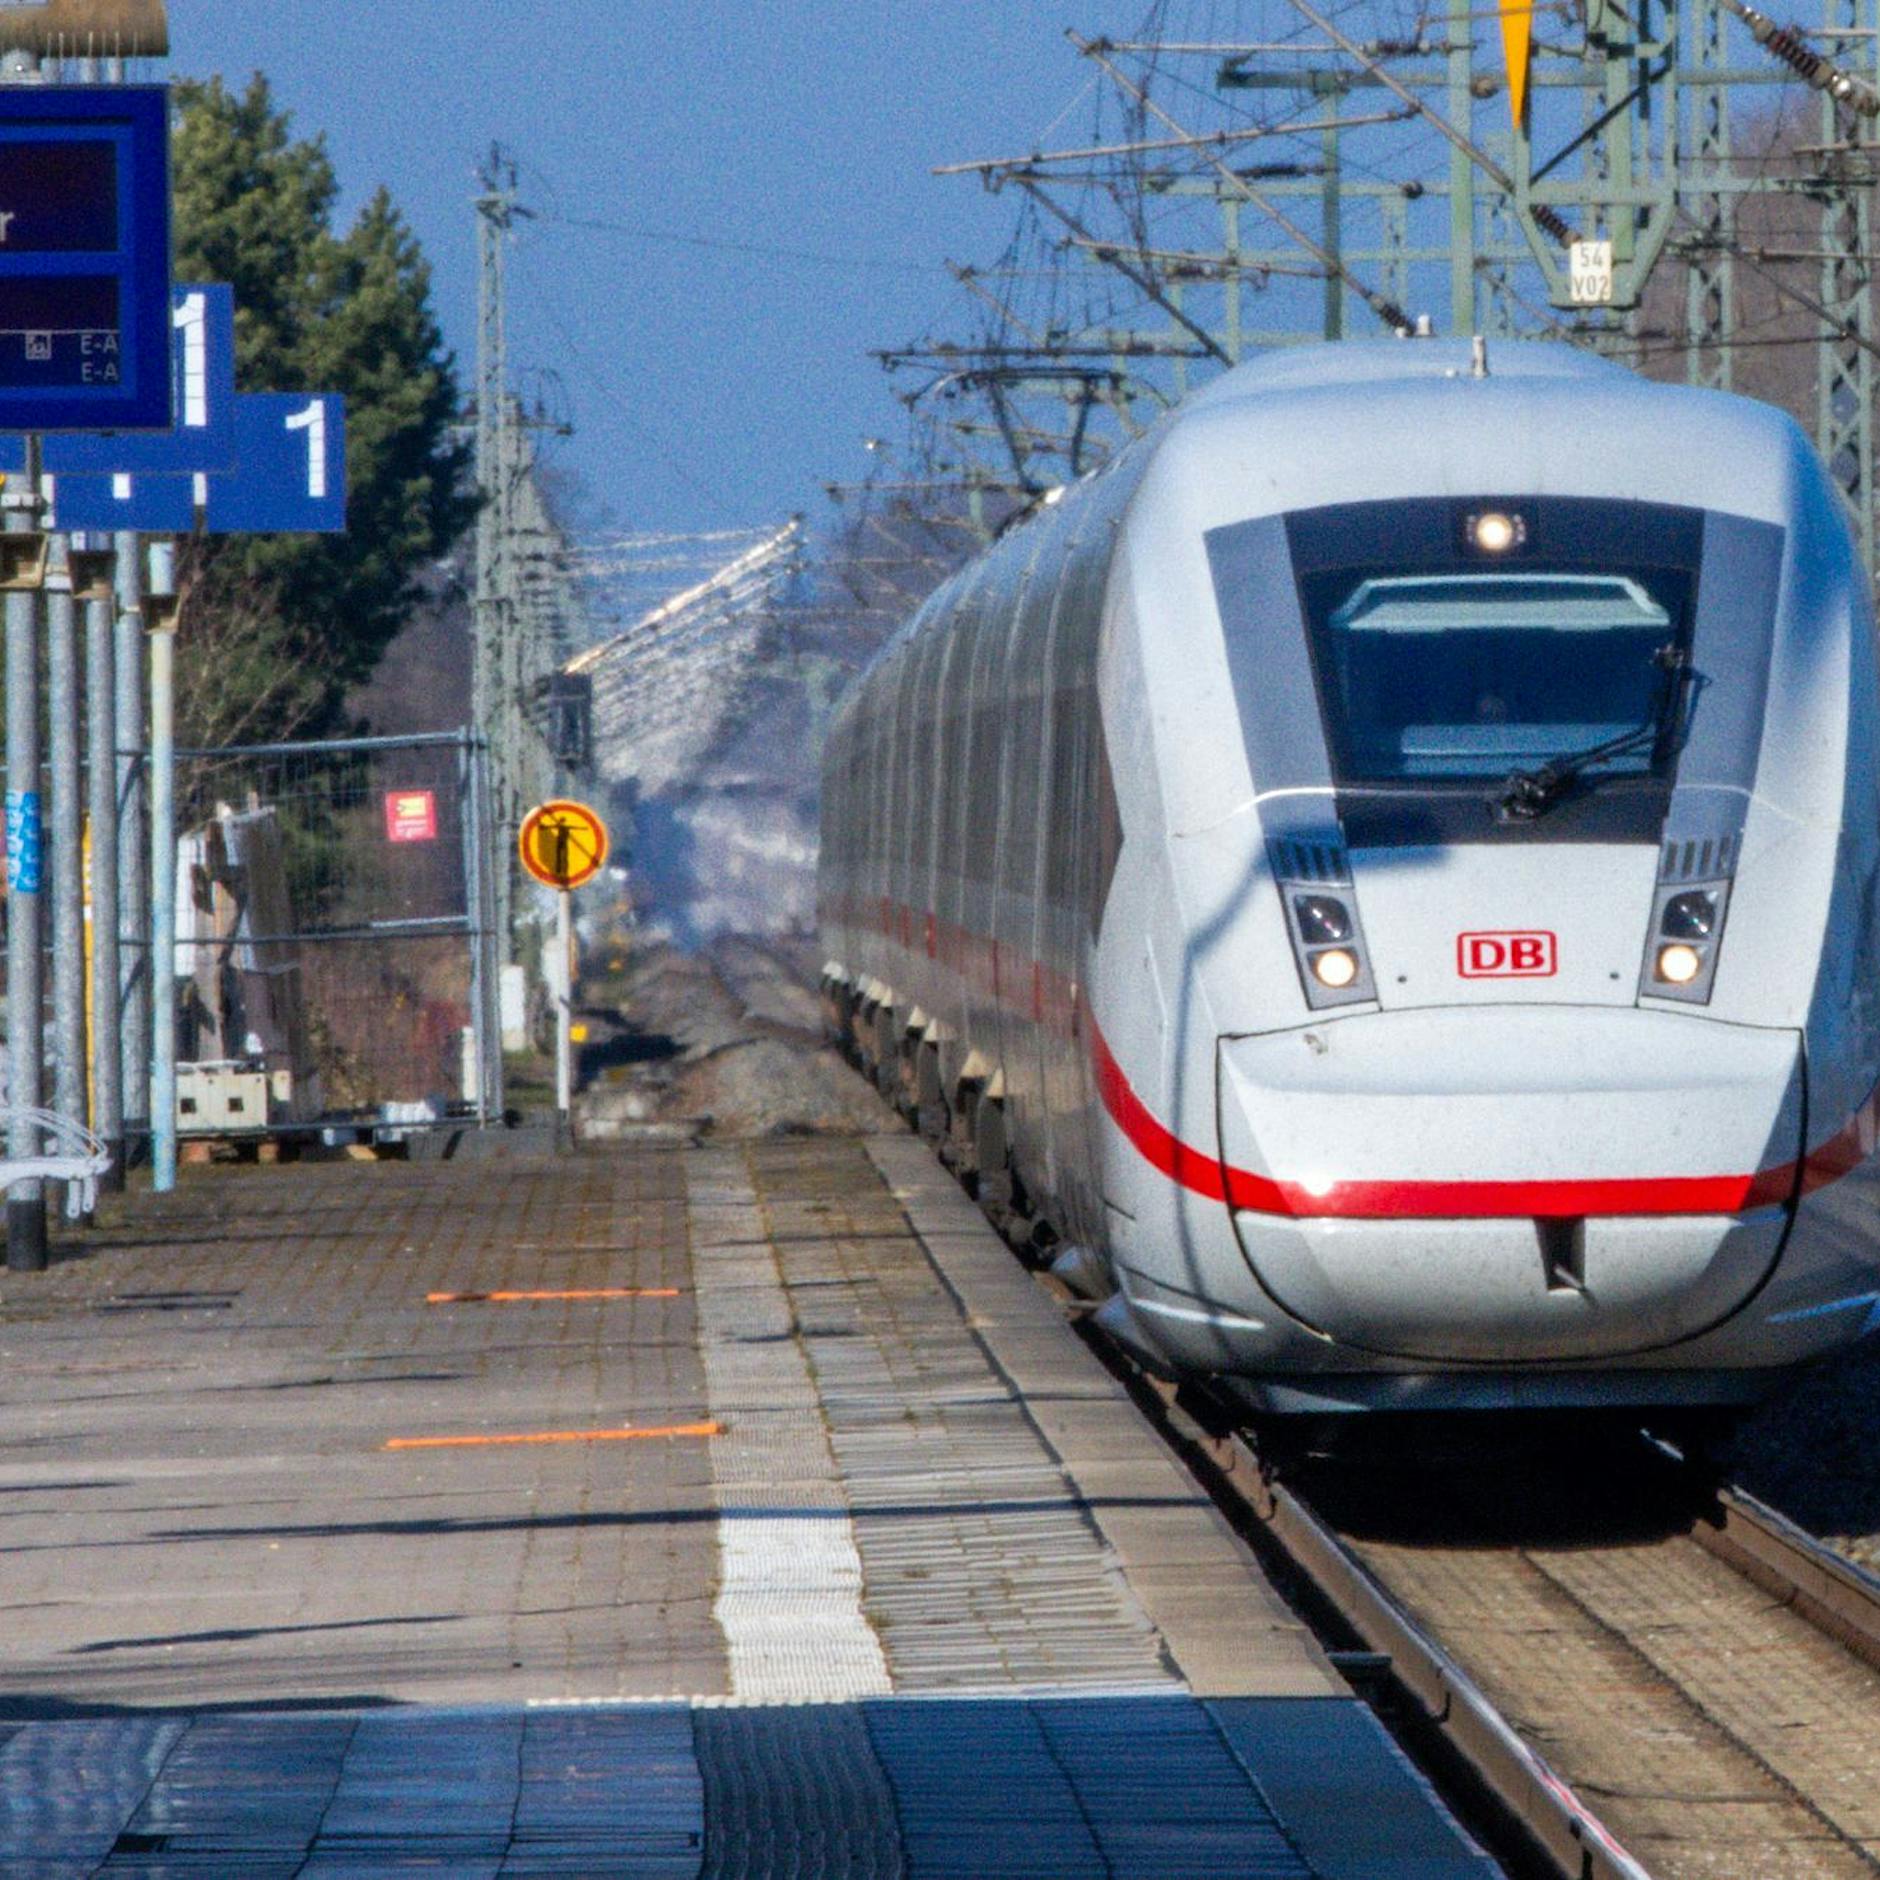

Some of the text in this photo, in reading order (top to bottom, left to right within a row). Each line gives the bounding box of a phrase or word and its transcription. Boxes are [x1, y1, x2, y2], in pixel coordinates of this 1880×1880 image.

[80, 334, 119, 355] E-A
[172, 293, 206, 427] 1
[81, 361, 119, 382] E-A
[285, 400, 326, 498] 1
[1470, 938, 1545, 970] DB
